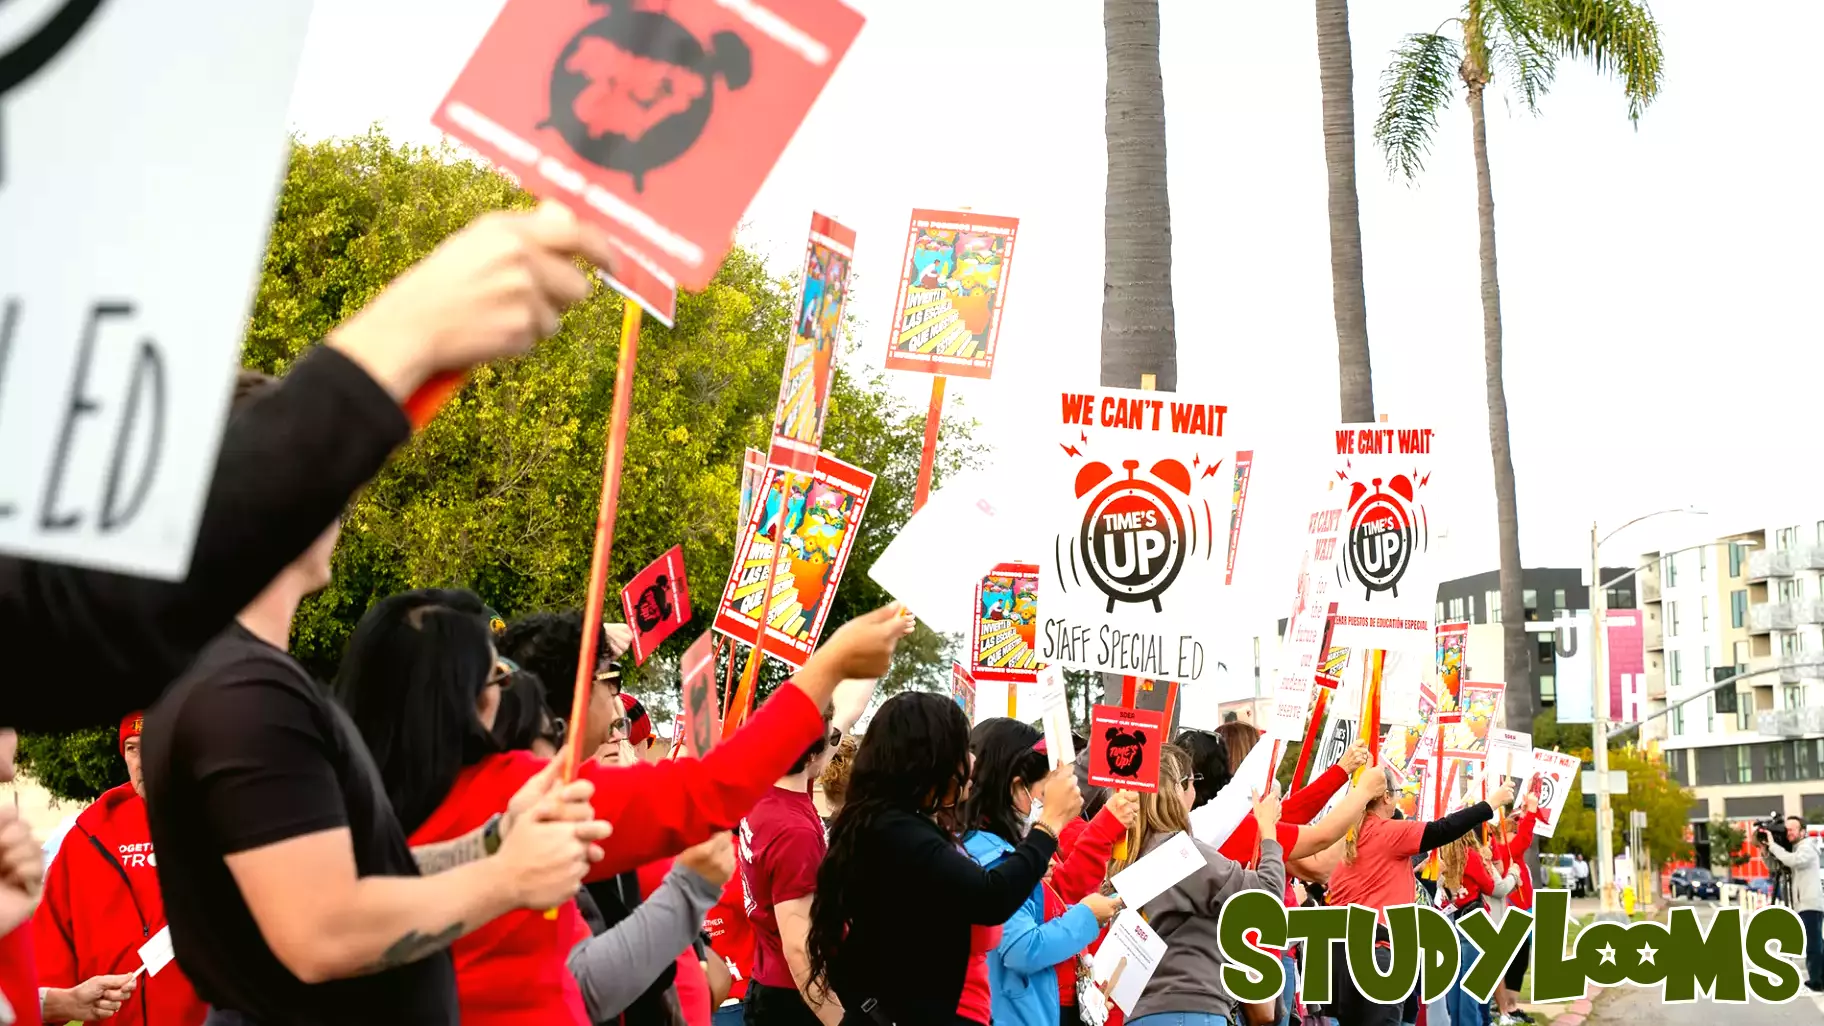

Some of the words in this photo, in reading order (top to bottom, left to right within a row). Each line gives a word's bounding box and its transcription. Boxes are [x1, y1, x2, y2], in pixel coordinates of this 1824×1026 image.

[909, 330, 930, 352] QUE
[38, 300, 168, 535] ED
[1062, 393, 1095, 426] WE
[1100, 396, 1164, 431] CAN'T
[1170, 402, 1228, 437] WAIT
[1335, 430, 1354, 454] WE
[1357, 429, 1394, 454] CAN'T
[1398, 429, 1432, 454] WAIT
[1103, 510, 1157, 532] TIME'S
[1317, 508, 1343, 534] CAN'T
[1362, 516, 1394, 536] TIME'S
[1104, 529, 1165, 578] UP
[1314, 537, 1337, 562] WAIT
[1362, 532, 1400, 573] UP
[1348, 616, 1369, 627] PUESTOS
[1370, 617, 1376, 627] DE
[1404, 619, 1429, 631] ESPECIAL
[1043, 618, 1091, 663] STAFF
[1097, 624, 1169, 676] SPECIAL
[1178, 635, 1204, 681] ED
[119, 842, 153, 853] OGET
[122, 853, 157, 867] TR
[702, 917, 724, 927] ETHER
